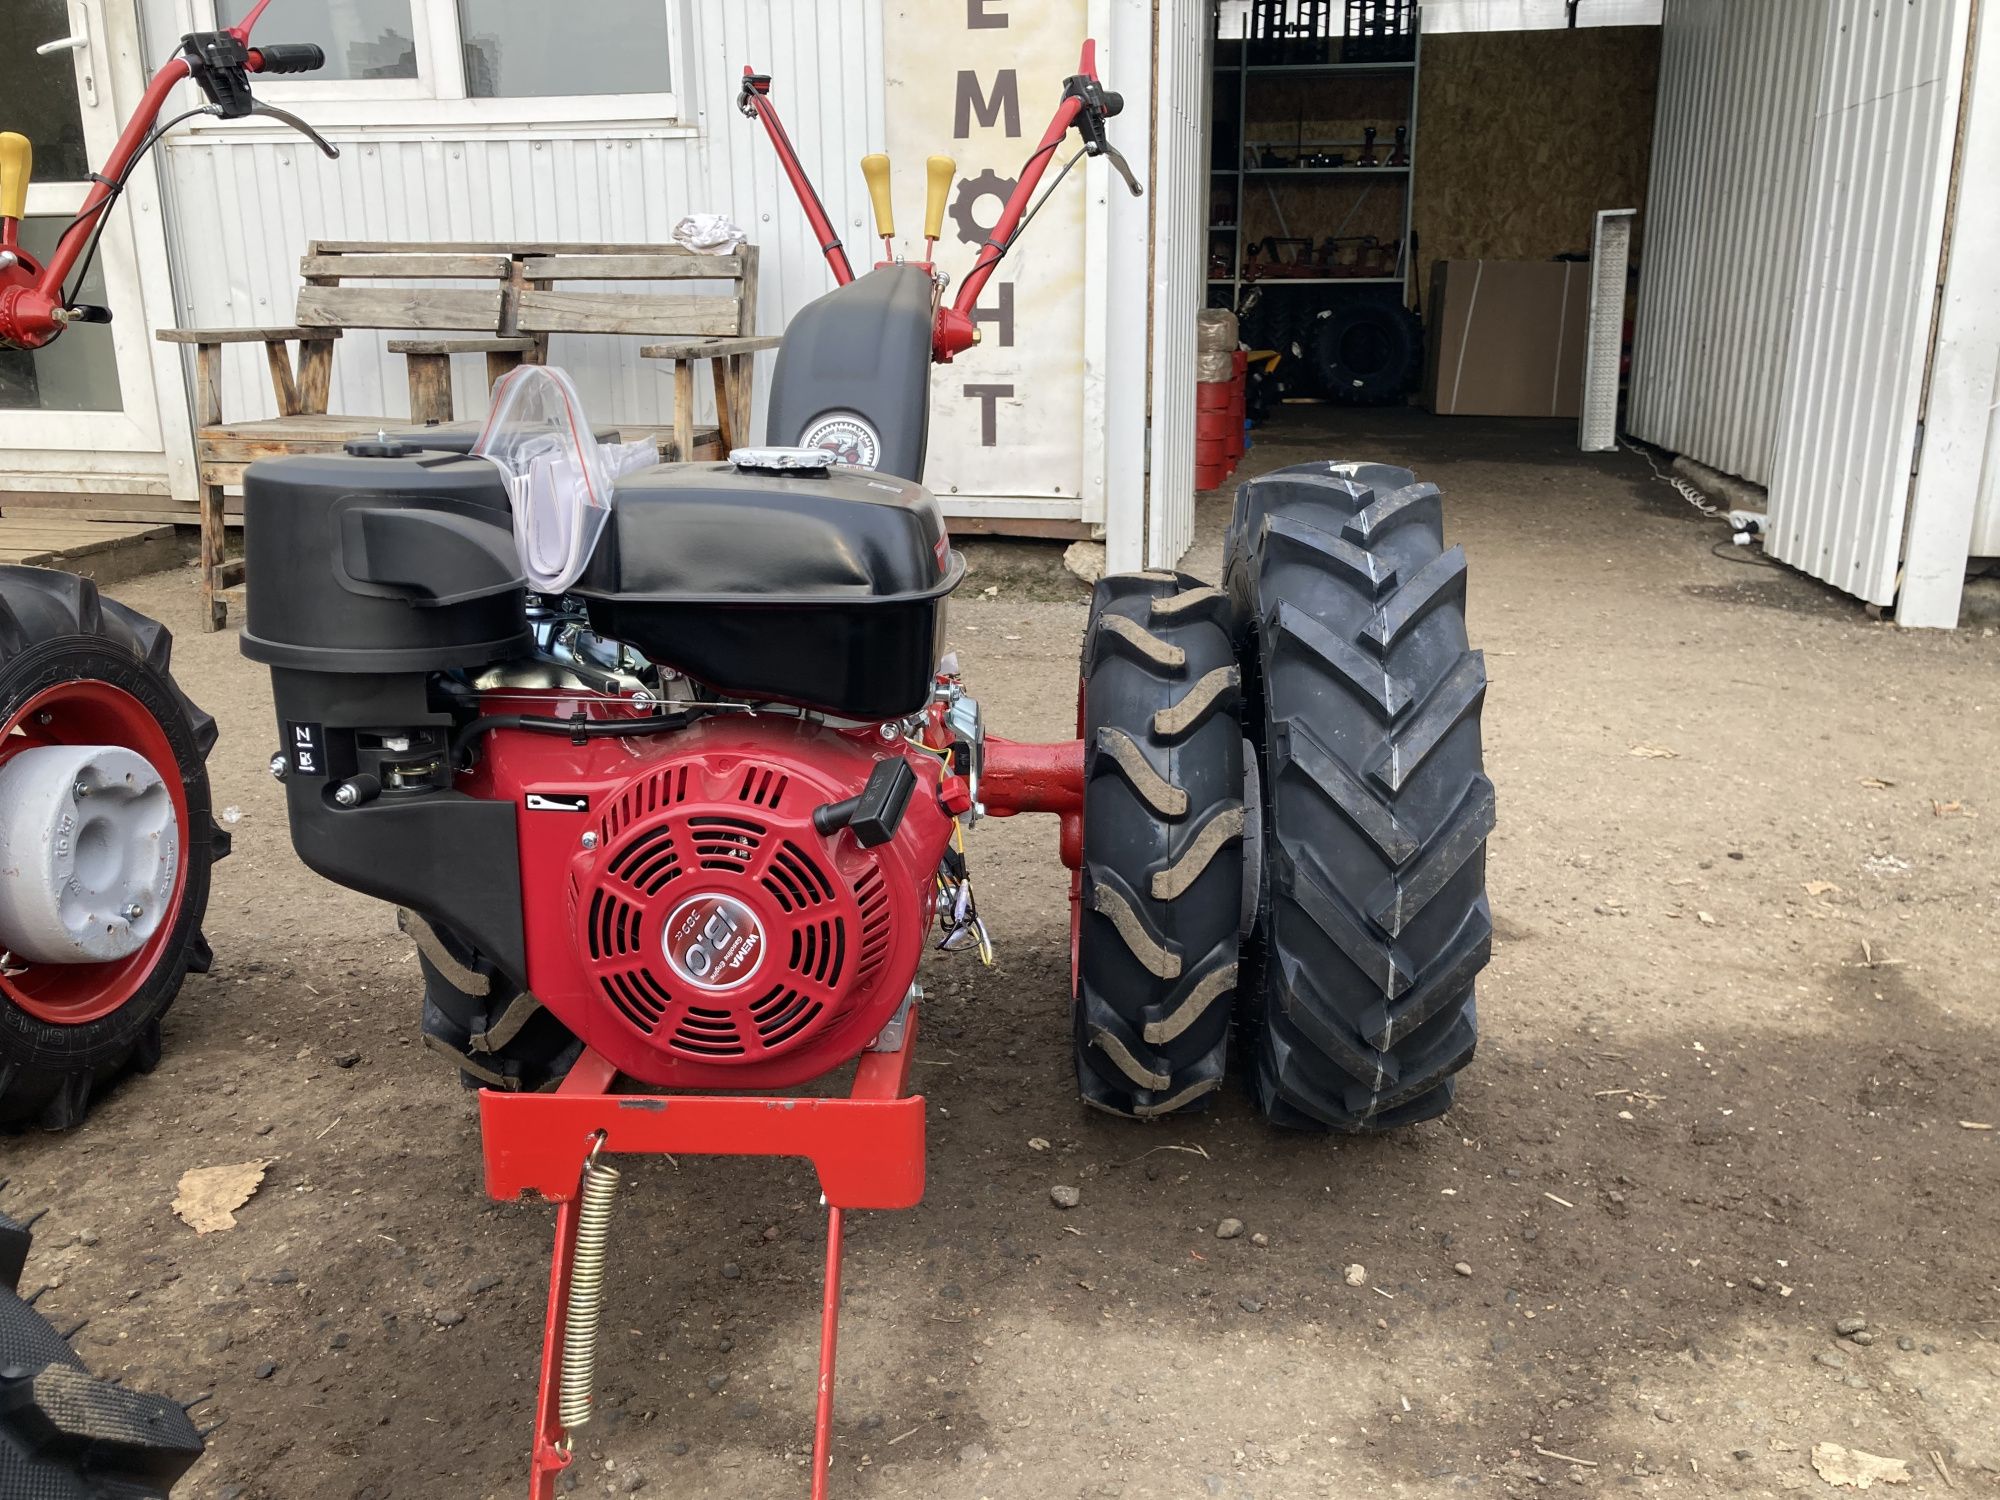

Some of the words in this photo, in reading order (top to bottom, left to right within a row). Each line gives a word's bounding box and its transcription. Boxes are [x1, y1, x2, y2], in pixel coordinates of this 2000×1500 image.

[681, 908, 701, 935] 389
[685, 906, 737, 976] 13.0
[723, 936, 743, 962] Gasoline
[729, 933, 759, 968] WEMA
[710, 960, 727, 981] Engine
